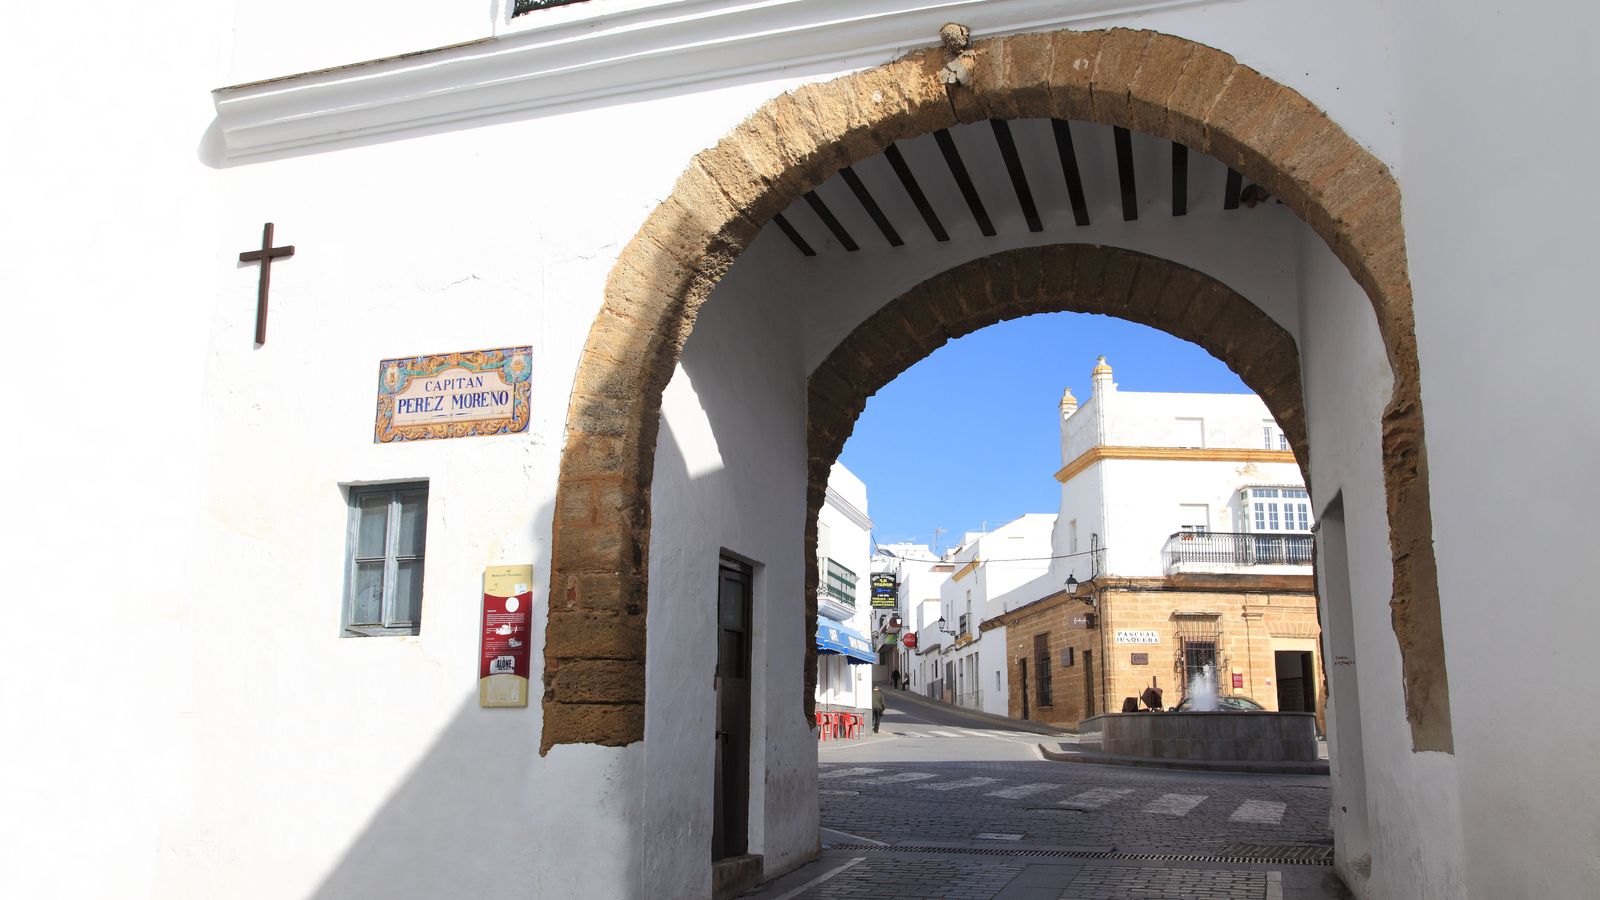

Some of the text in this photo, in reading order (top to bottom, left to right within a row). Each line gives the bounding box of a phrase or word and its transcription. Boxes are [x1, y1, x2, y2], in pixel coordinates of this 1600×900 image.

[424, 376, 484, 393] CAPITAN
[397, 390, 509, 415] PEREZ MORENO
